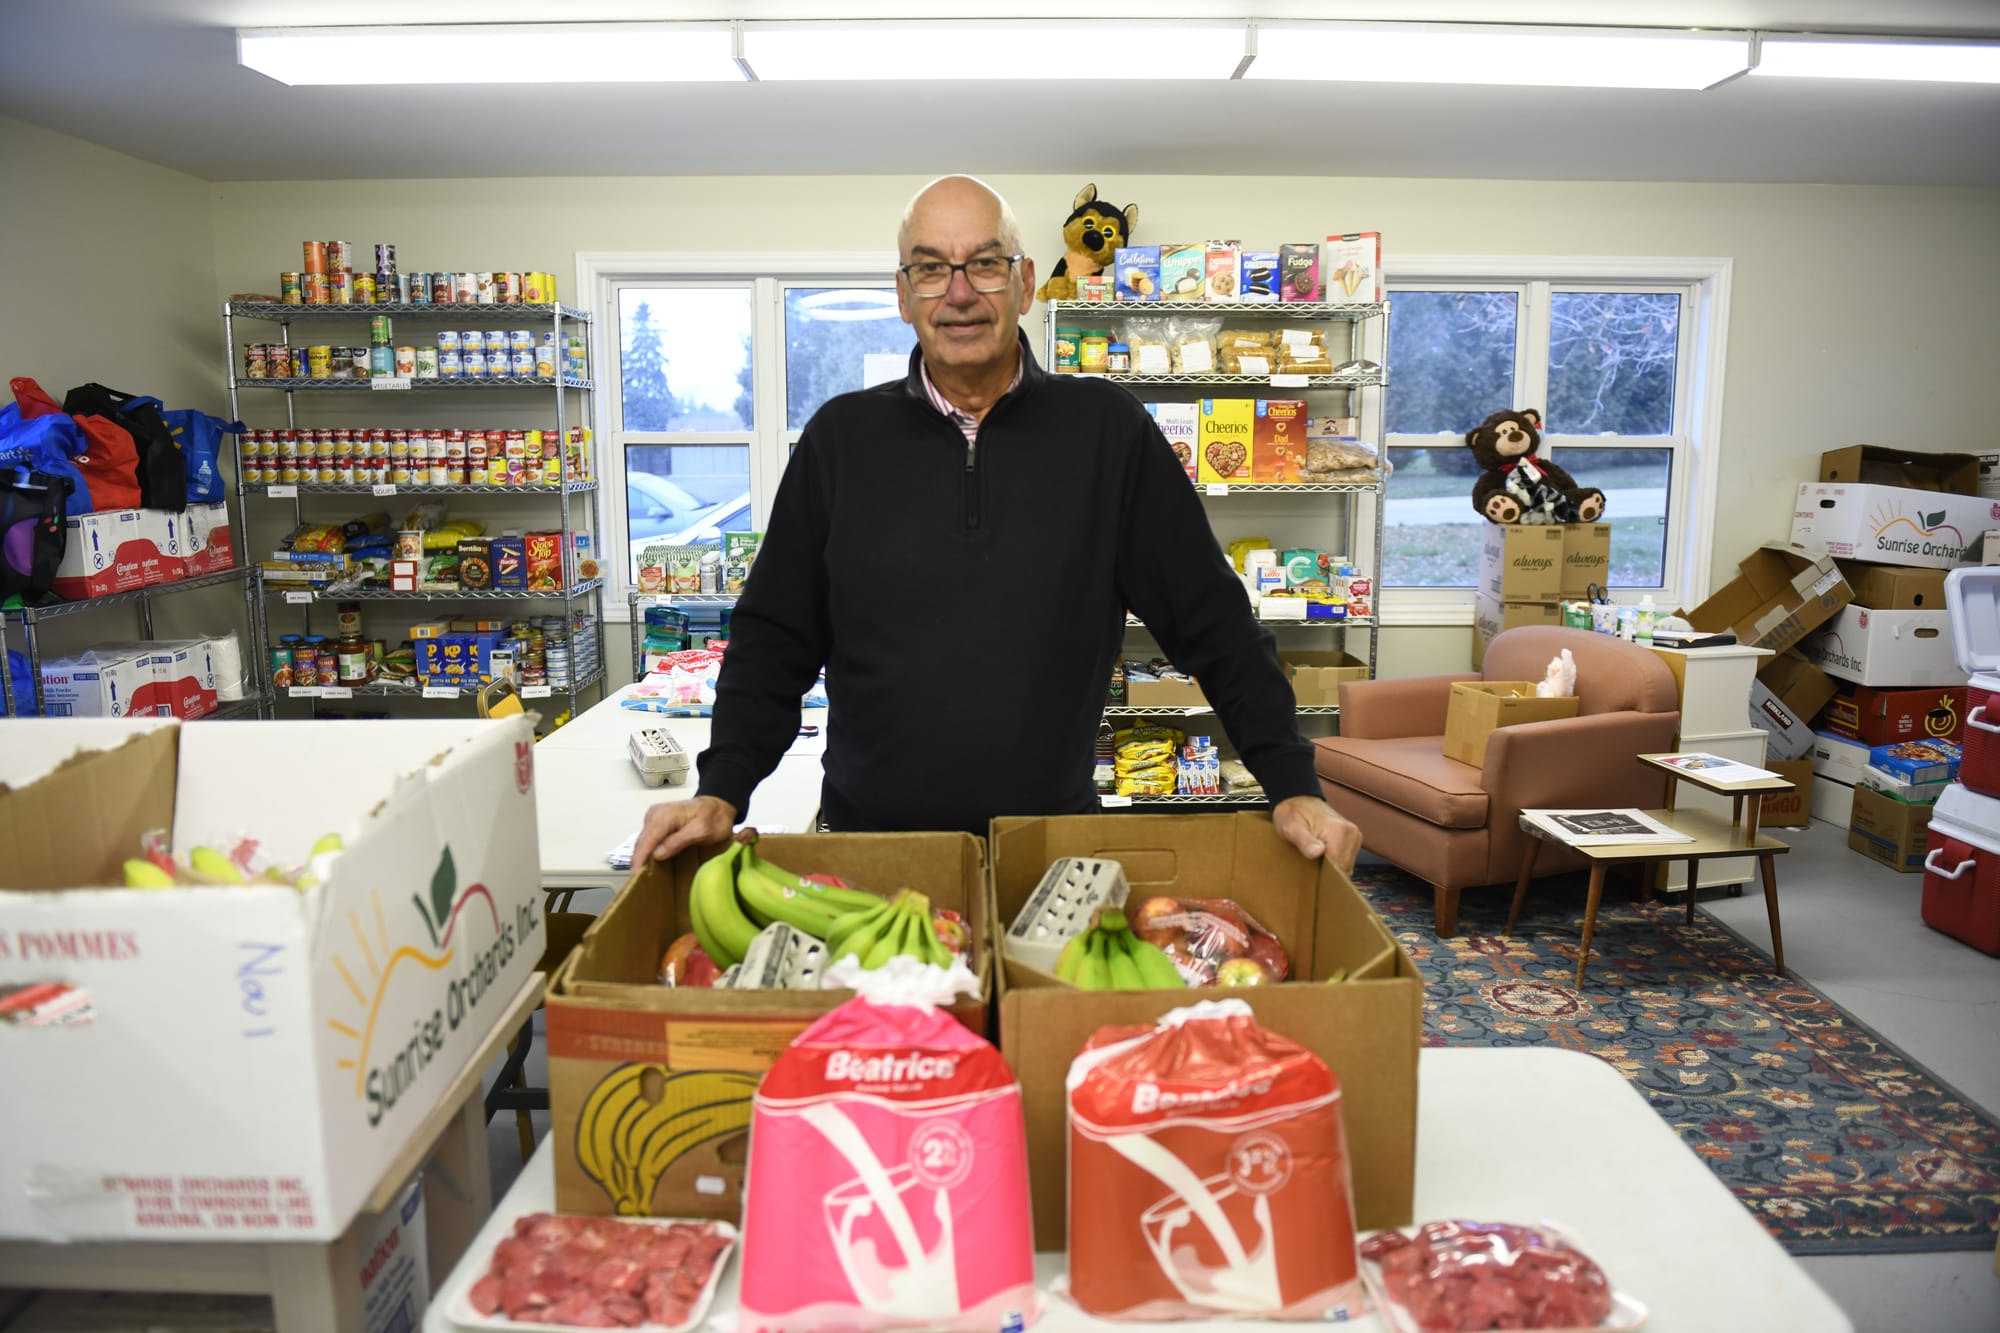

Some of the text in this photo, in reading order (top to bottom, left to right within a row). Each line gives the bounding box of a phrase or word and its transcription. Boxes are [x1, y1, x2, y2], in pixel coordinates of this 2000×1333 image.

[1288, 256, 1313, 268] Fudge
[372, 382, 410, 390] VEGETABLES
[1267, 407, 1297, 418] Cheerios
[1156, 421, 1194, 436] heerios
[1205, 419, 1248, 434] Cheerios
[1273, 434, 1289, 443] Dad
[528, 538, 555, 560] Stove Top
[1877, 535, 1919, 555] Sunrise
[1922, 541, 1968, 560] Orchard
[1513, 554, 1553, 572] always
[1566, 552, 1607, 568] always
[1820, 647, 1850, 669] Orchards
[1765, 700, 1792, 726] KIRKLAND
[17, 930, 141, 962] POMMES
[366, 1008, 445, 1128] Sunrise
[447, 922, 515, 1032] Orchards
[825, 1050, 956, 1082] Beatrice
[181, 1177, 270, 1194] ORCHARDS
